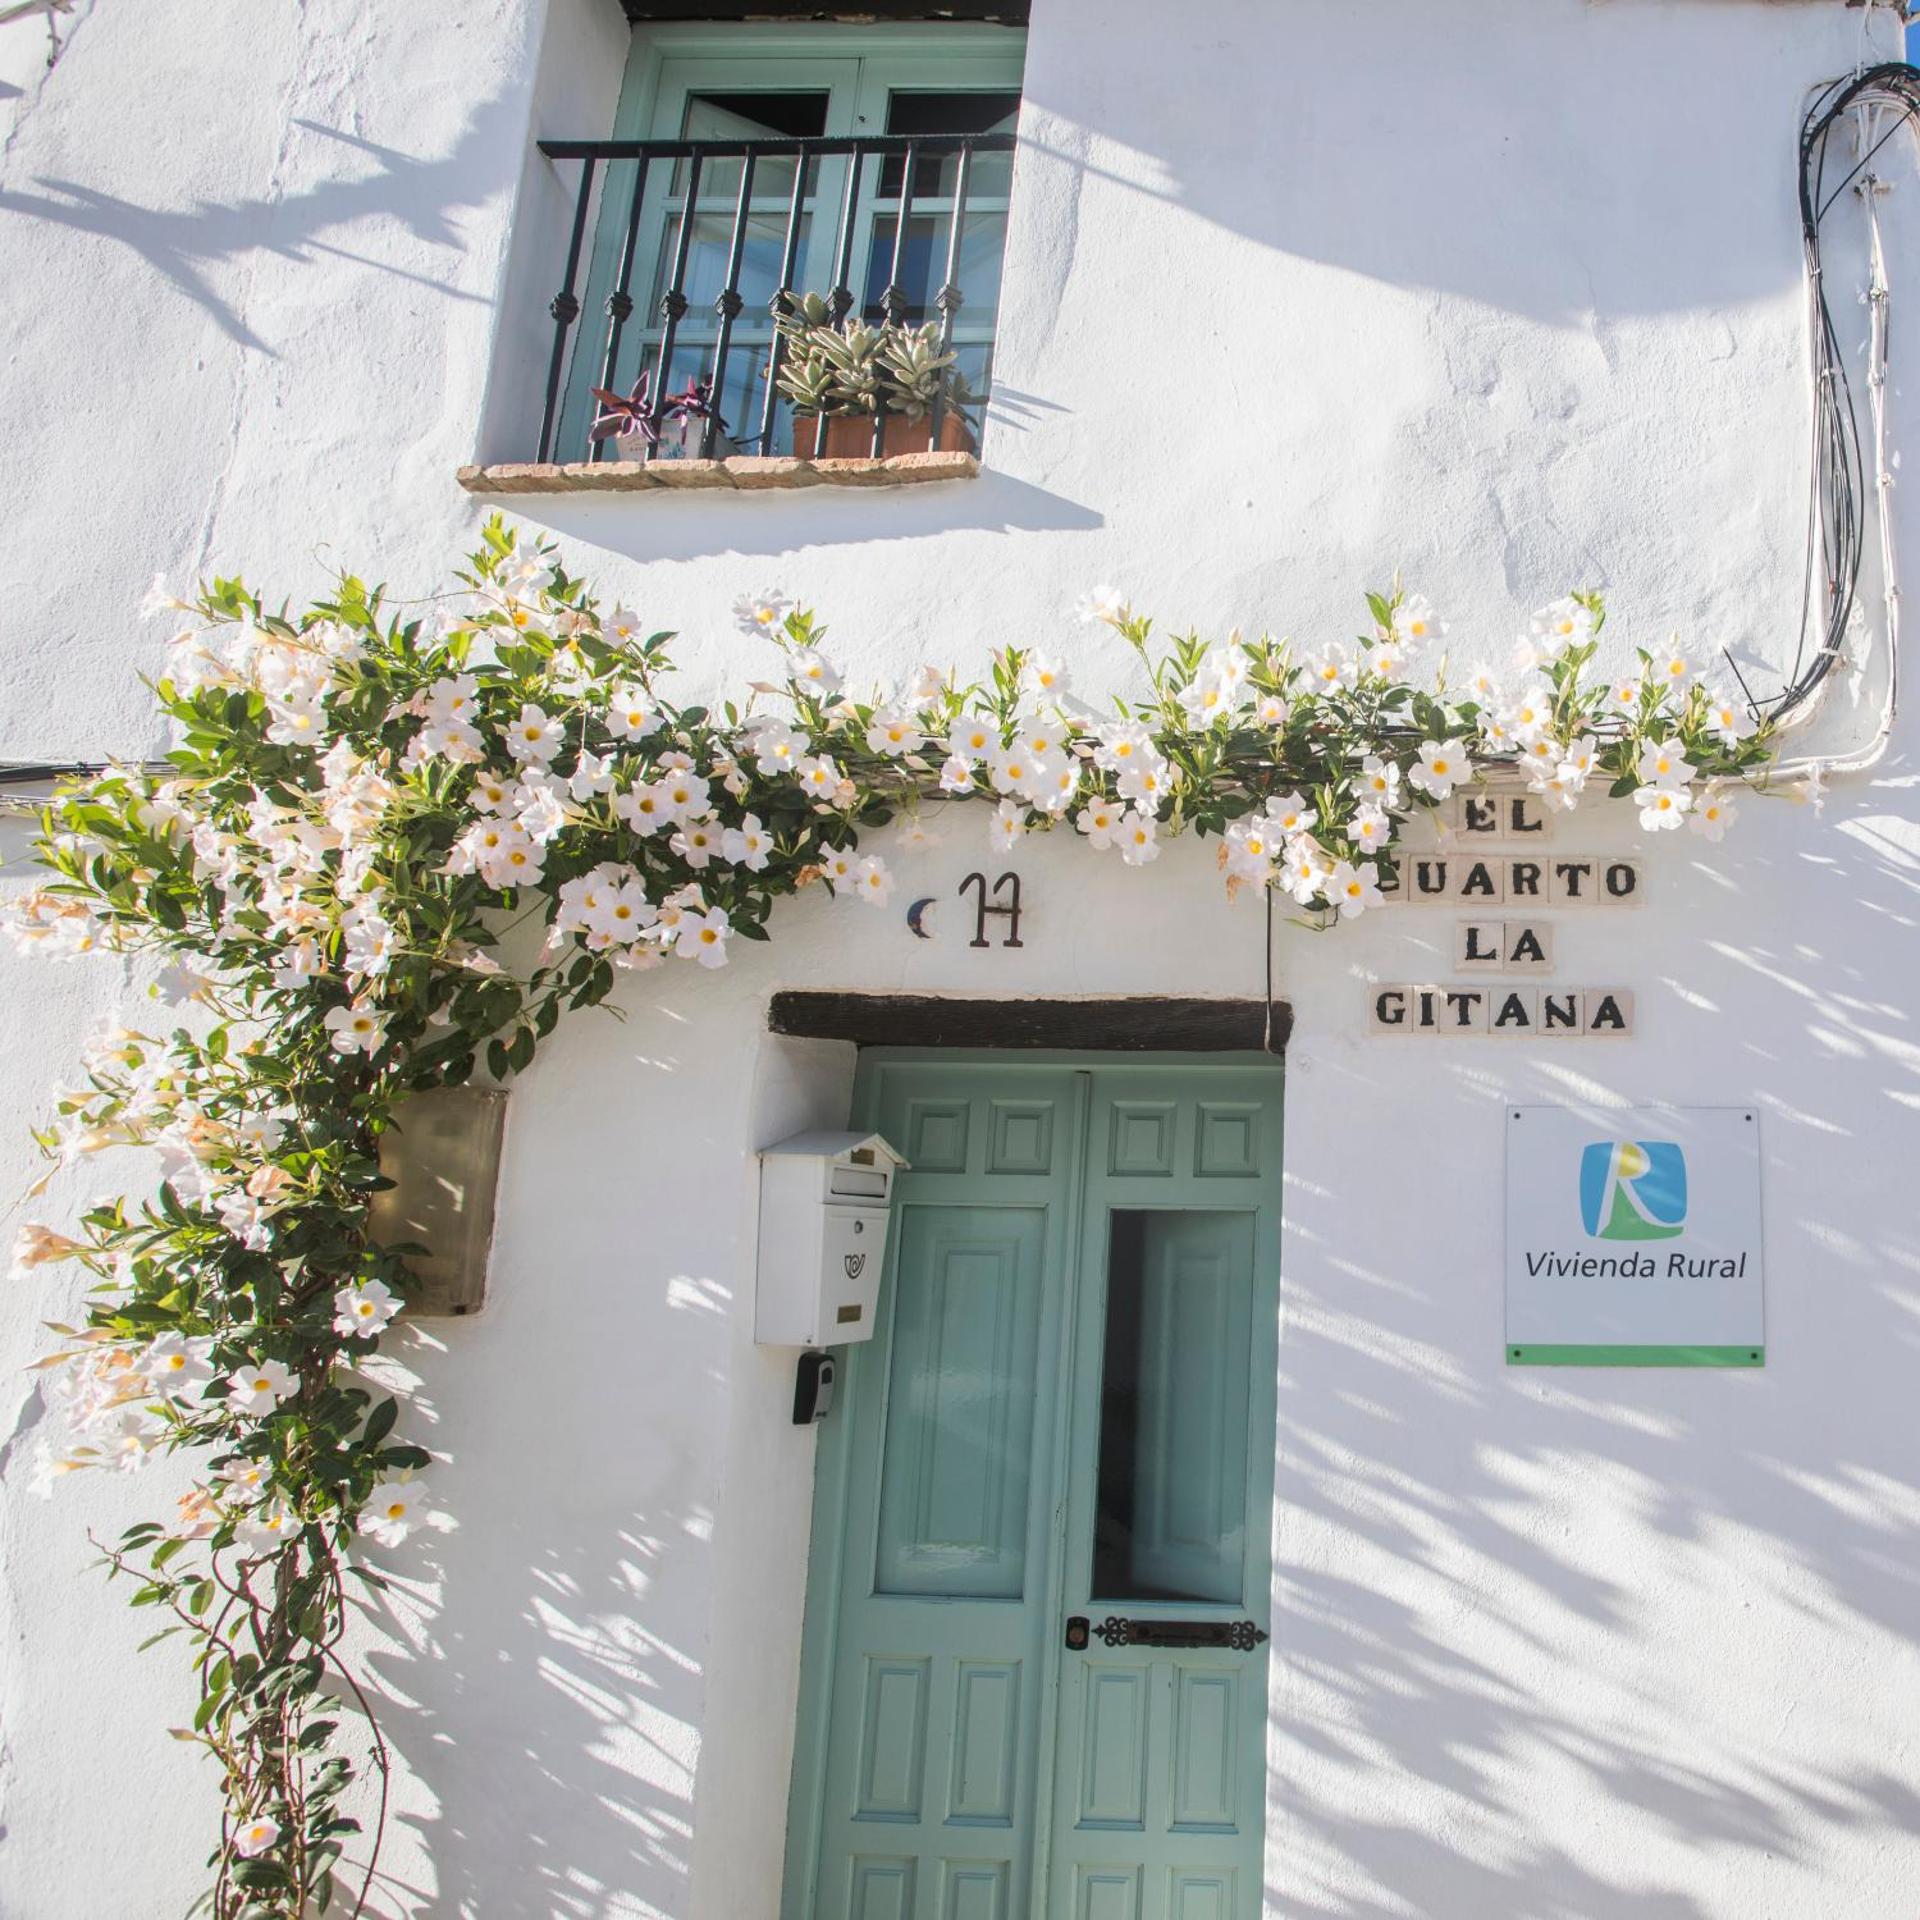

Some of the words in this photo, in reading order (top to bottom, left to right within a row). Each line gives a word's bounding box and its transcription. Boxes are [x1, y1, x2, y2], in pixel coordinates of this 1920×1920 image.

[1466, 798, 1543, 832] EL
[1464, 927, 1546, 962] LA
[1375, 991, 1626, 1029] GITANA
[1525, 1251, 1656, 1278] Vivienda
[1666, 1251, 1747, 1278] Rural
